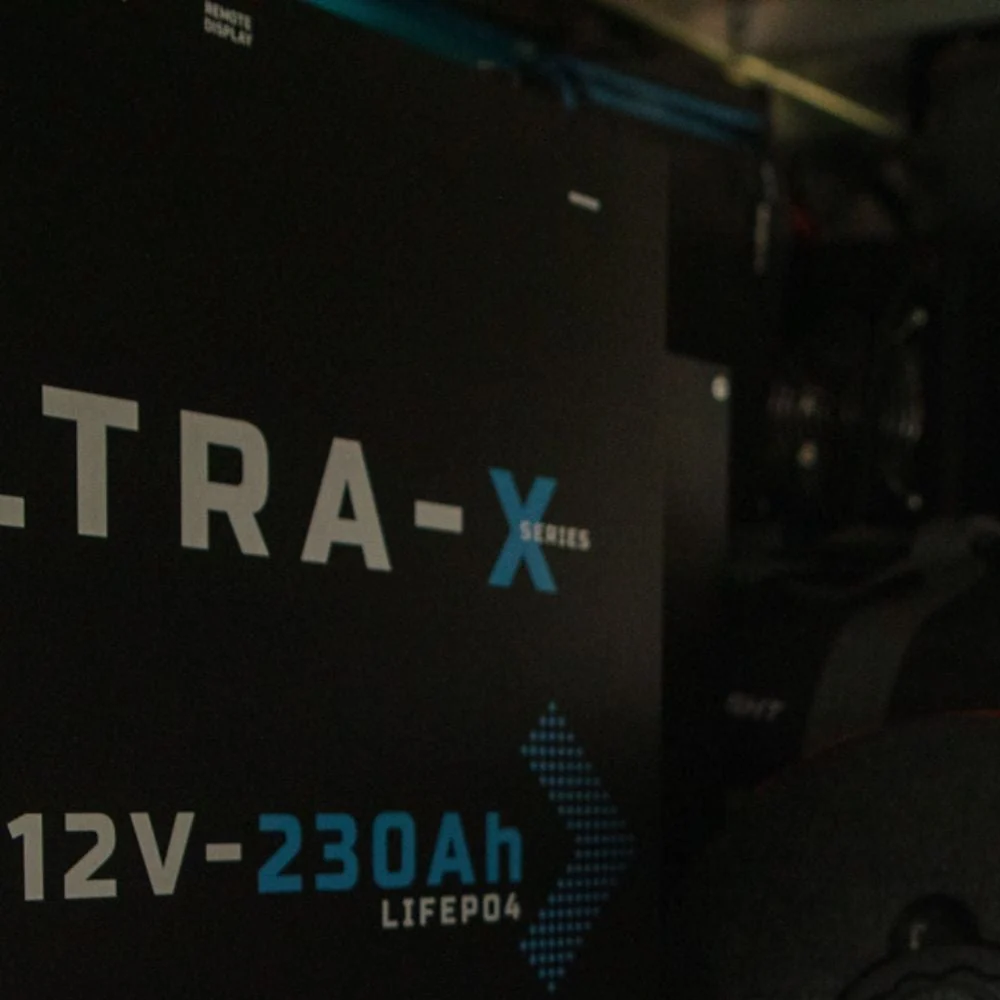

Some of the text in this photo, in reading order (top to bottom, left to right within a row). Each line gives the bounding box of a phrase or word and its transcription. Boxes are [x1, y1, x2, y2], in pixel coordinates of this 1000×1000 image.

[0, 384, 558, 594] TRA-X
[519, 519, 591, 551] SERIES
[7, 811, 524, 901] 12V-230Ah
